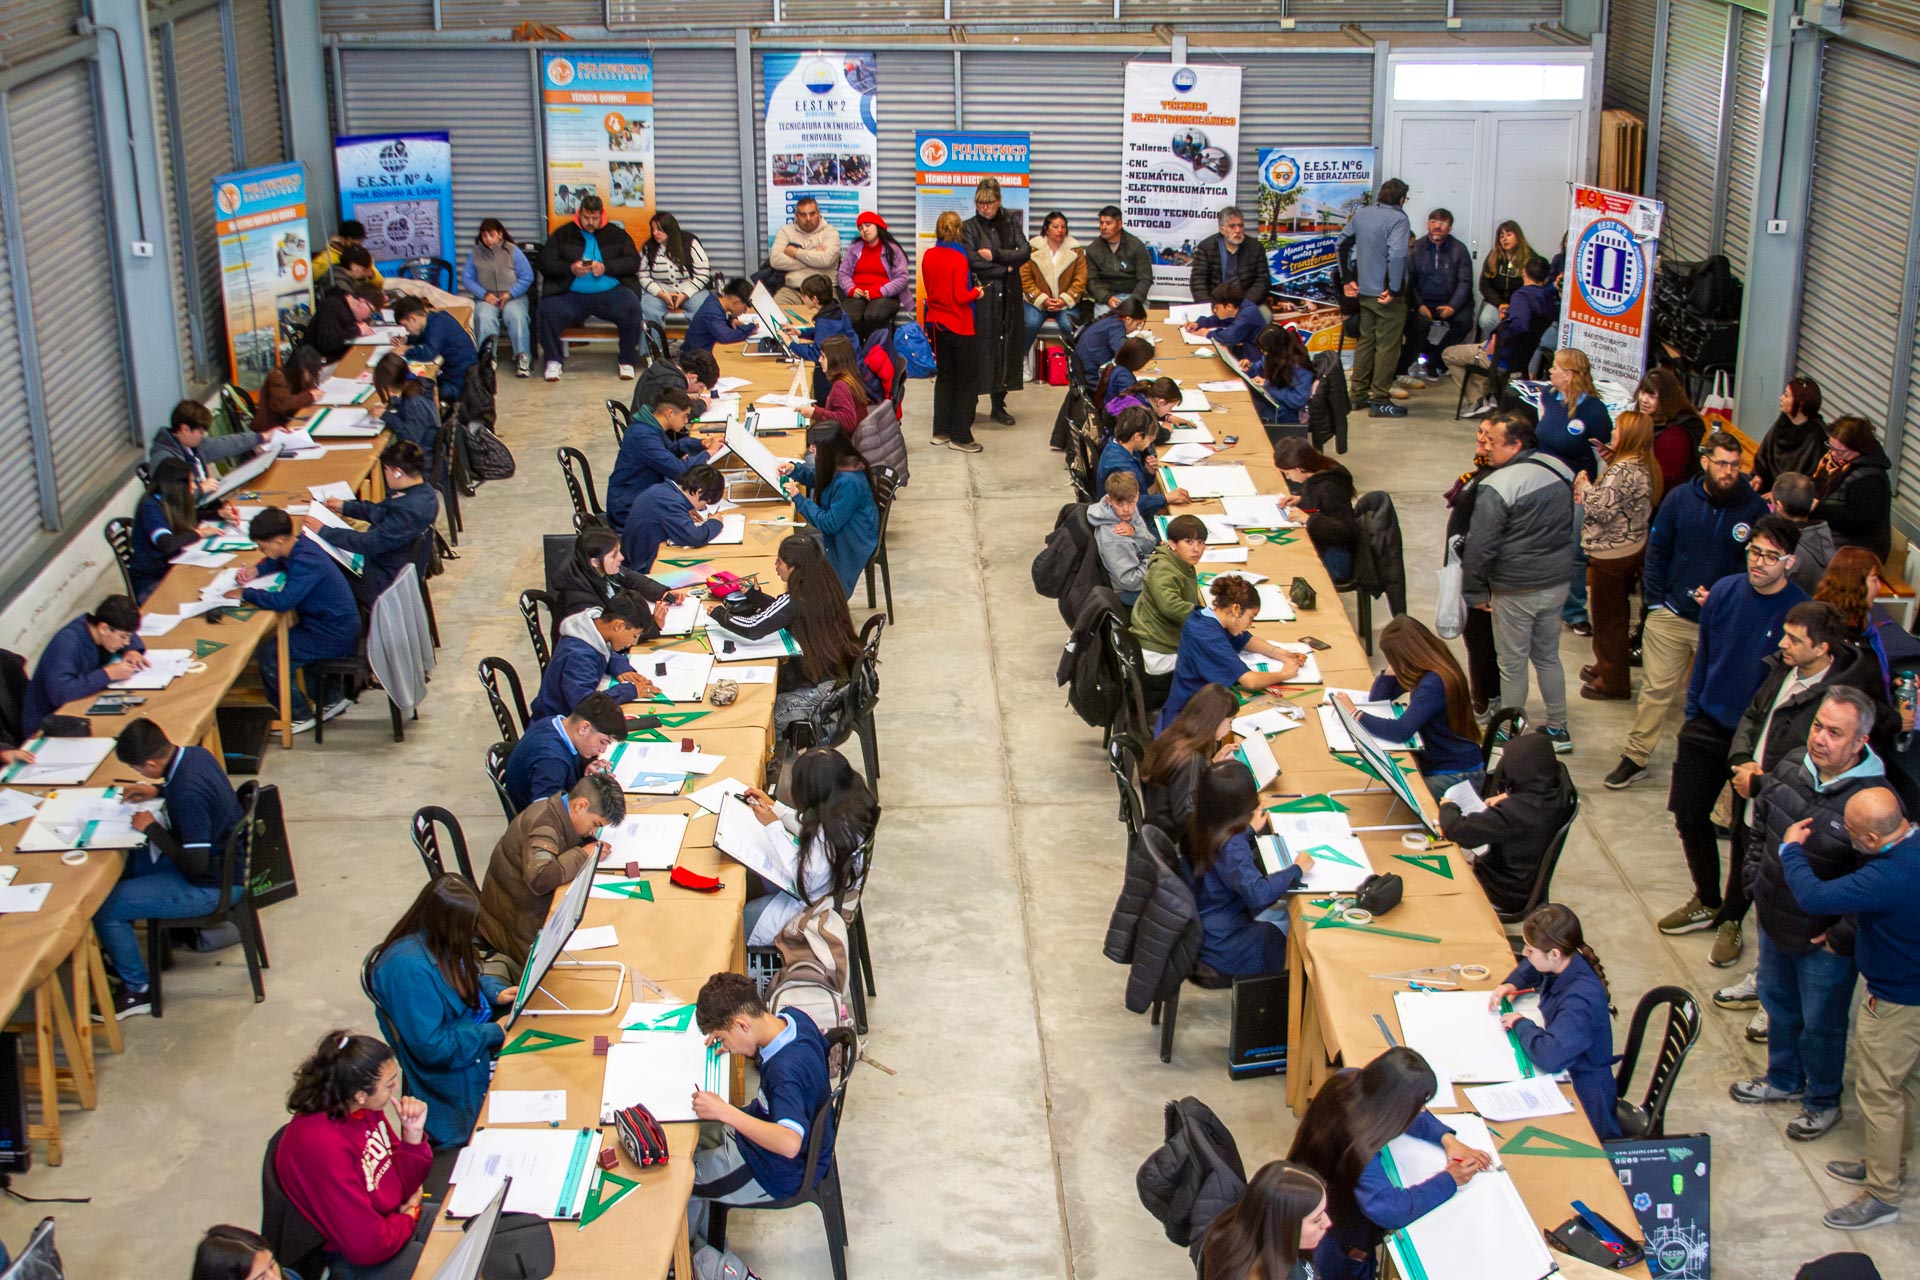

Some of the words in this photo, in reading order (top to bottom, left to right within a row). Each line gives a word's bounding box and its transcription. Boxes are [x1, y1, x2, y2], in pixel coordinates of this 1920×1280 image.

[841, 100, 846, 112] 2
[779, 122, 821, 131] TECNICATURA
[823, 121, 832, 130] EN
[833, 121, 864, 131] ENERGÍAS
[801, 133, 842, 142] RENOVABLES
[952, 143, 1027, 155] POLITECNICO
[1129, 143, 1171, 153] Talleres:
[1304, 161, 1340, 171] E.E.S.T.
[356, 175, 401, 188] E.E.S.T.
[424, 173, 434, 184] 4
[953, 175, 961, 184] EN
[1303, 172, 1315, 181] DE
[1316, 171, 1370, 181] BERAZATEGUI
[372, 188, 404, 199] Ricardo
[418, 187, 442, 199] López
[1597, 219, 1616, 231] EEST
[1283, 245, 1304, 257] Manos
[1304, 243, 1316, 251] que
[1292, 250, 1312, 261] mentes
[1312, 247, 1323, 256] que
[1570, 310, 1640, 336] BERAZATEGUI
[1583, 330, 1609, 343] MAESTRO
[1608, 338, 1628, 348] MAYOR
[1590, 341, 1599, 349] DE
[1599, 343, 1617, 354] OBRAS
[1594, 356, 1602, 364] EN
[1601, 366, 1640, 382] PROFESIONAL
[1661, 1249, 1685, 1257] PIZZINI
